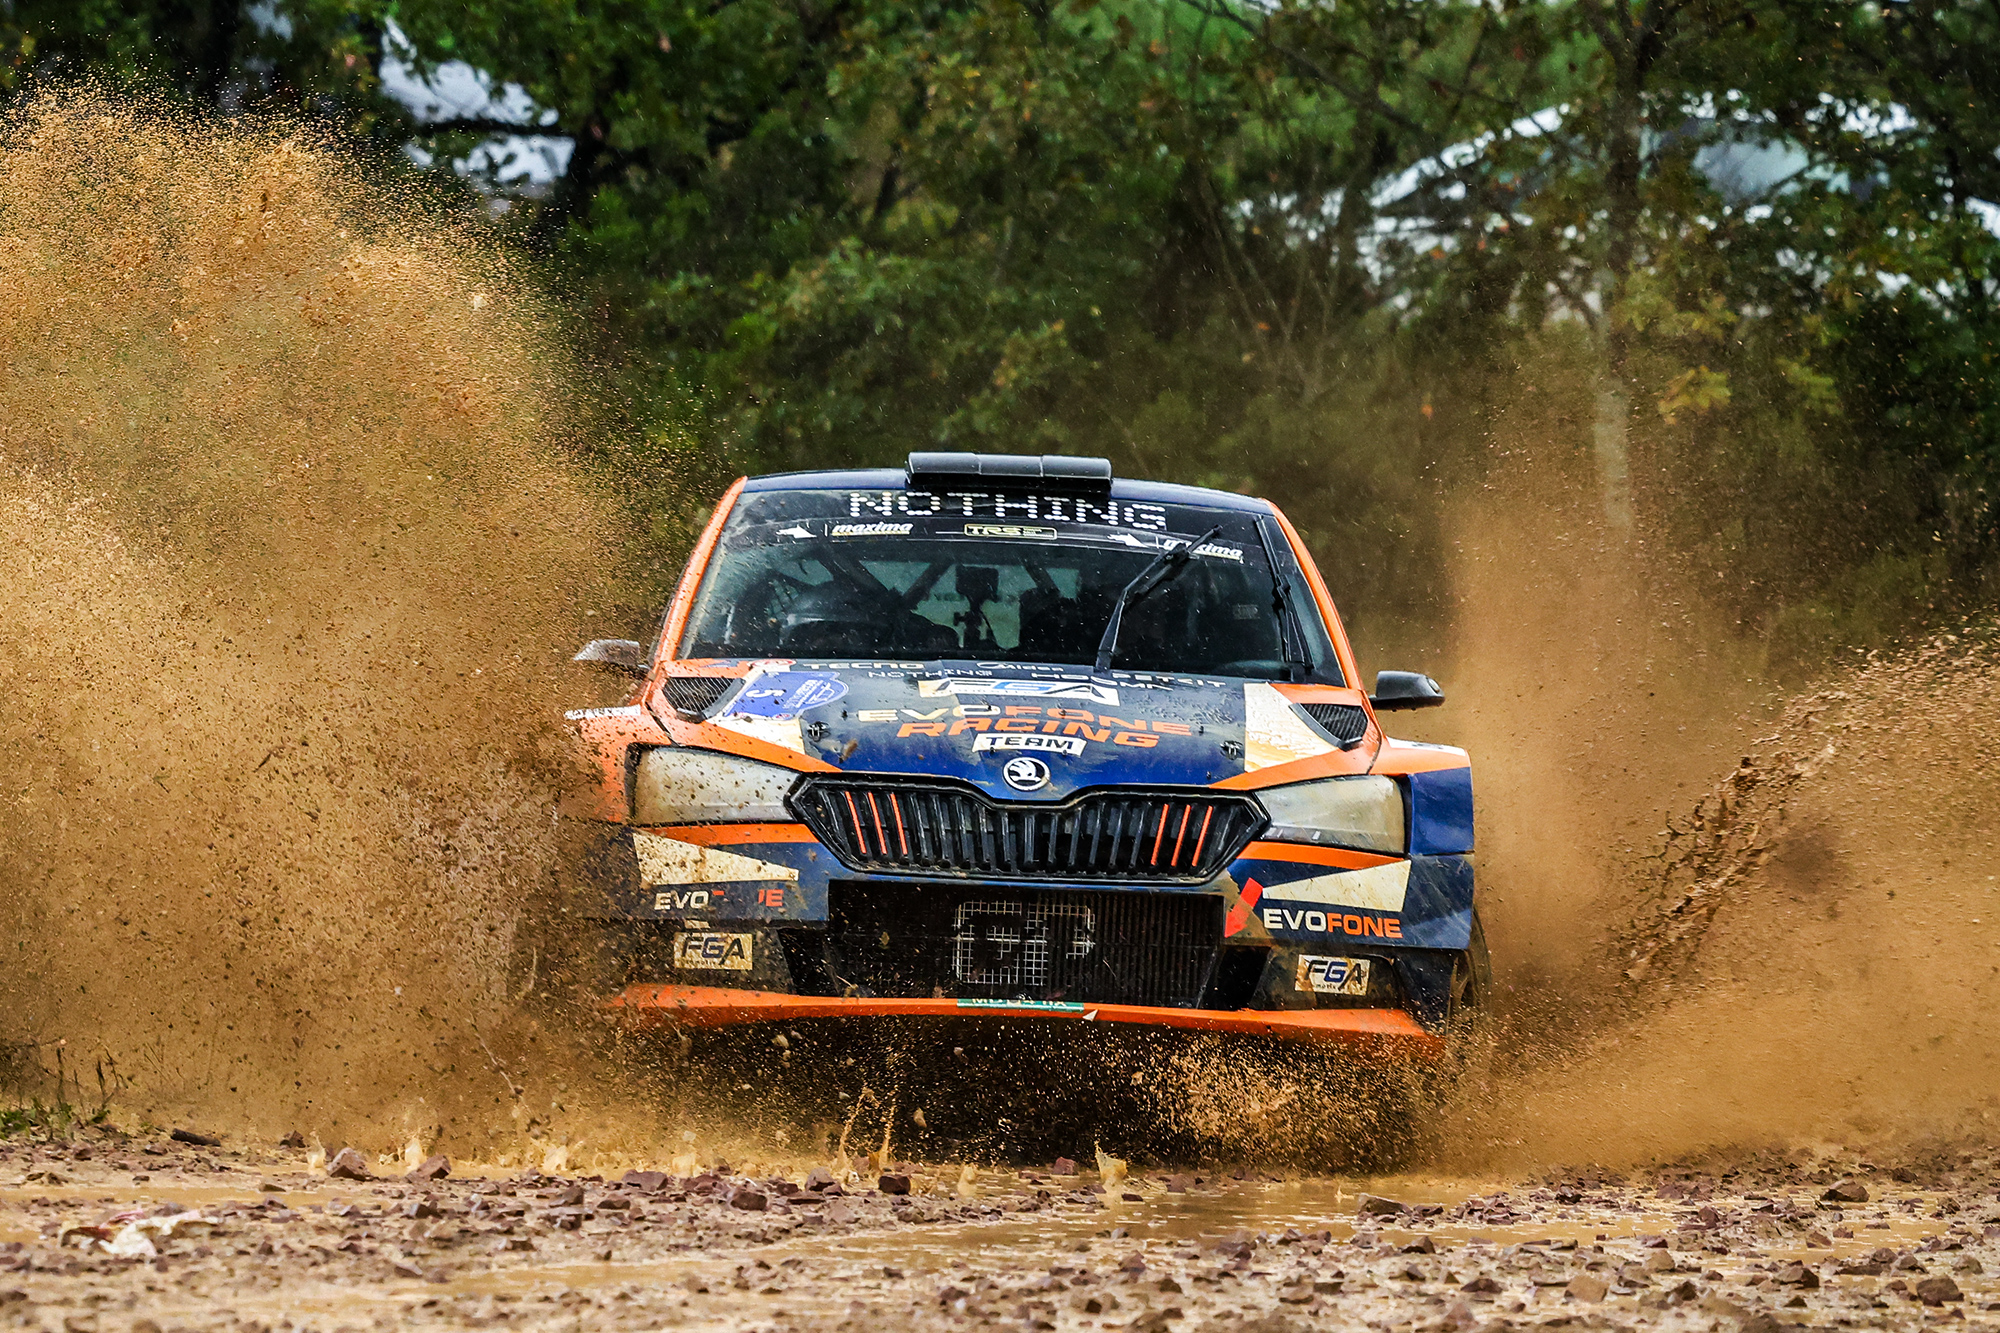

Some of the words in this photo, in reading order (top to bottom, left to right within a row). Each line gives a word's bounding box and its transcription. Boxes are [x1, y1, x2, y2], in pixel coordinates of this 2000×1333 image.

[849, 491, 1166, 530] NOTHING
[832, 521, 914, 535] maxima
[968, 525, 1021, 535] TRS
[1163, 539, 1243, 560] mxima
[803, 662, 925, 670] TECNO
[868, 669, 993, 679] NOTHING
[857, 705, 1192, 736] EVOFONE
[896, 717, 1161, 749] RACING
[984, 736, 1074, 750] TEAM
[1263, 908, 1403, 939] EVOFONE
[681, 936, 745, 966] FGA
[1304, 959, 1363, 992] FGA
